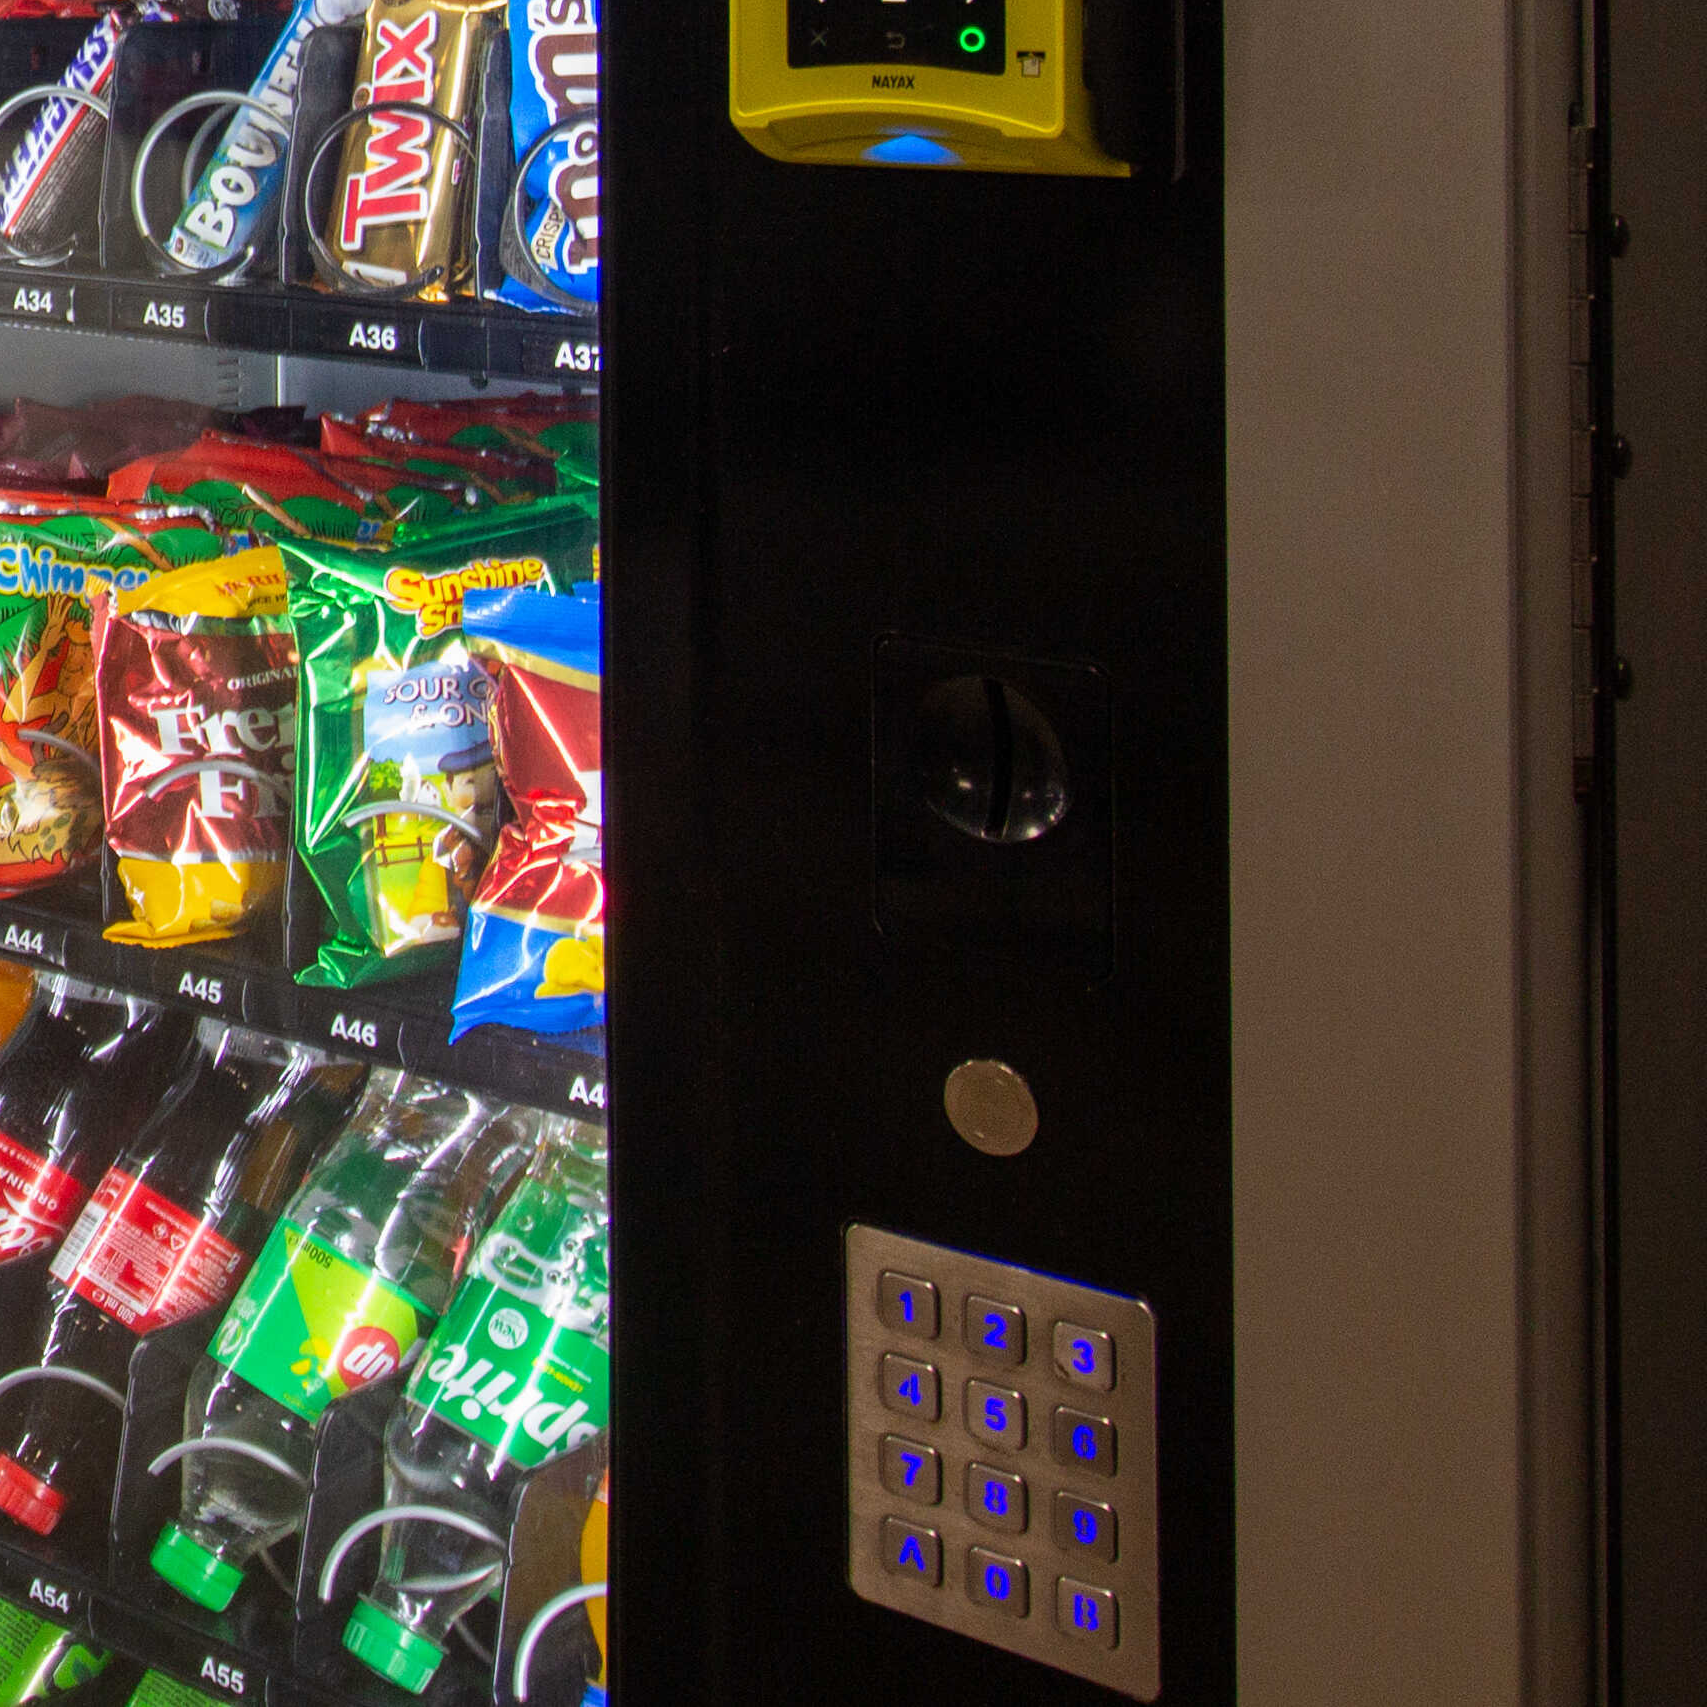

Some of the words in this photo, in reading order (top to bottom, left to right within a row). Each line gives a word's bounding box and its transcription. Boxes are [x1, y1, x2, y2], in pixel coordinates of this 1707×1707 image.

[871, 74, 916, 90] NAYAX
[534, 204, 564, 262] CRISP
[14, 290, 54, 314] A34
[143, 302, 185, 328] A35
[349, 323, 396, 350] A36
[554, 342, 602, 371] A37
[384, 558, 548, 612] Sunshine
[419, 602, 464, 637] Sn
[384, 677, 463, 703] SOUR
[440, 701, 488, 727] ON
[3, 924, 43, 953] A44
[178, 973, 222, 1004] A45
[330, 1015, 377, 1047] A46
[570, 1076, 605, 1109] A4
[899, 1291, 914, 1322] 1
[984, 1313, 1007, 1349] 2
[1072, 1339, 1095, 1374] 3
[899, 1373, 922, 1406] 4
[984, 1397, 1007, 1431] 5
[1072, 1424, 1097, 1460] 6
[900, 1452, 924, 1486] 7
[984, 1481, 1008, 1516] 8
[1073, 1509, 1097, 1544] 9
[29, 1577, 70, 1614] A54
[899, 1536, 926, 1572] A
[985, 1565, 1011, 1600] 0
[1073, 1594, 1099, 1631] B
[200, 1656, 245, 1695] A55
